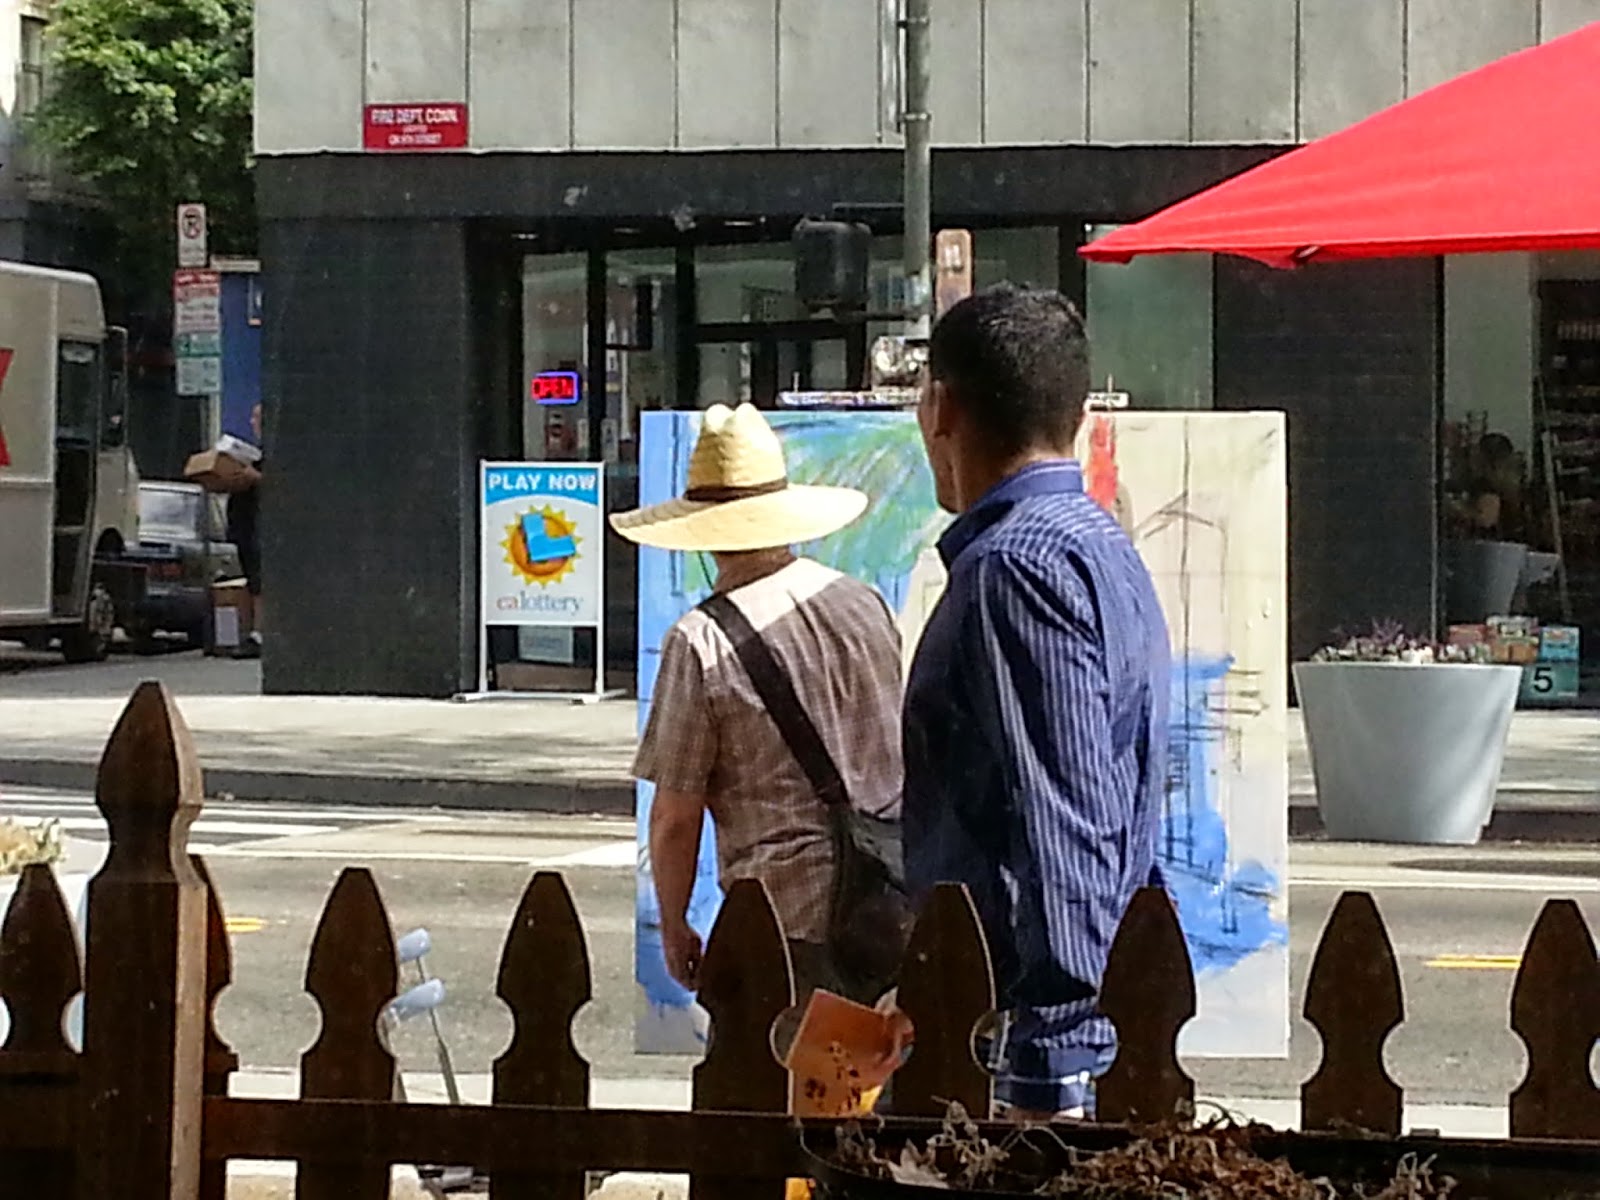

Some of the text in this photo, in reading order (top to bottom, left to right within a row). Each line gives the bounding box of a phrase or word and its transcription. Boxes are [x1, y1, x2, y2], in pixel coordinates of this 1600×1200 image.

[532, 378, 573, 399] OPEN
[488, 472, 596, 491] PLAY NOW
[1533, 666, 1554, 693] 5
